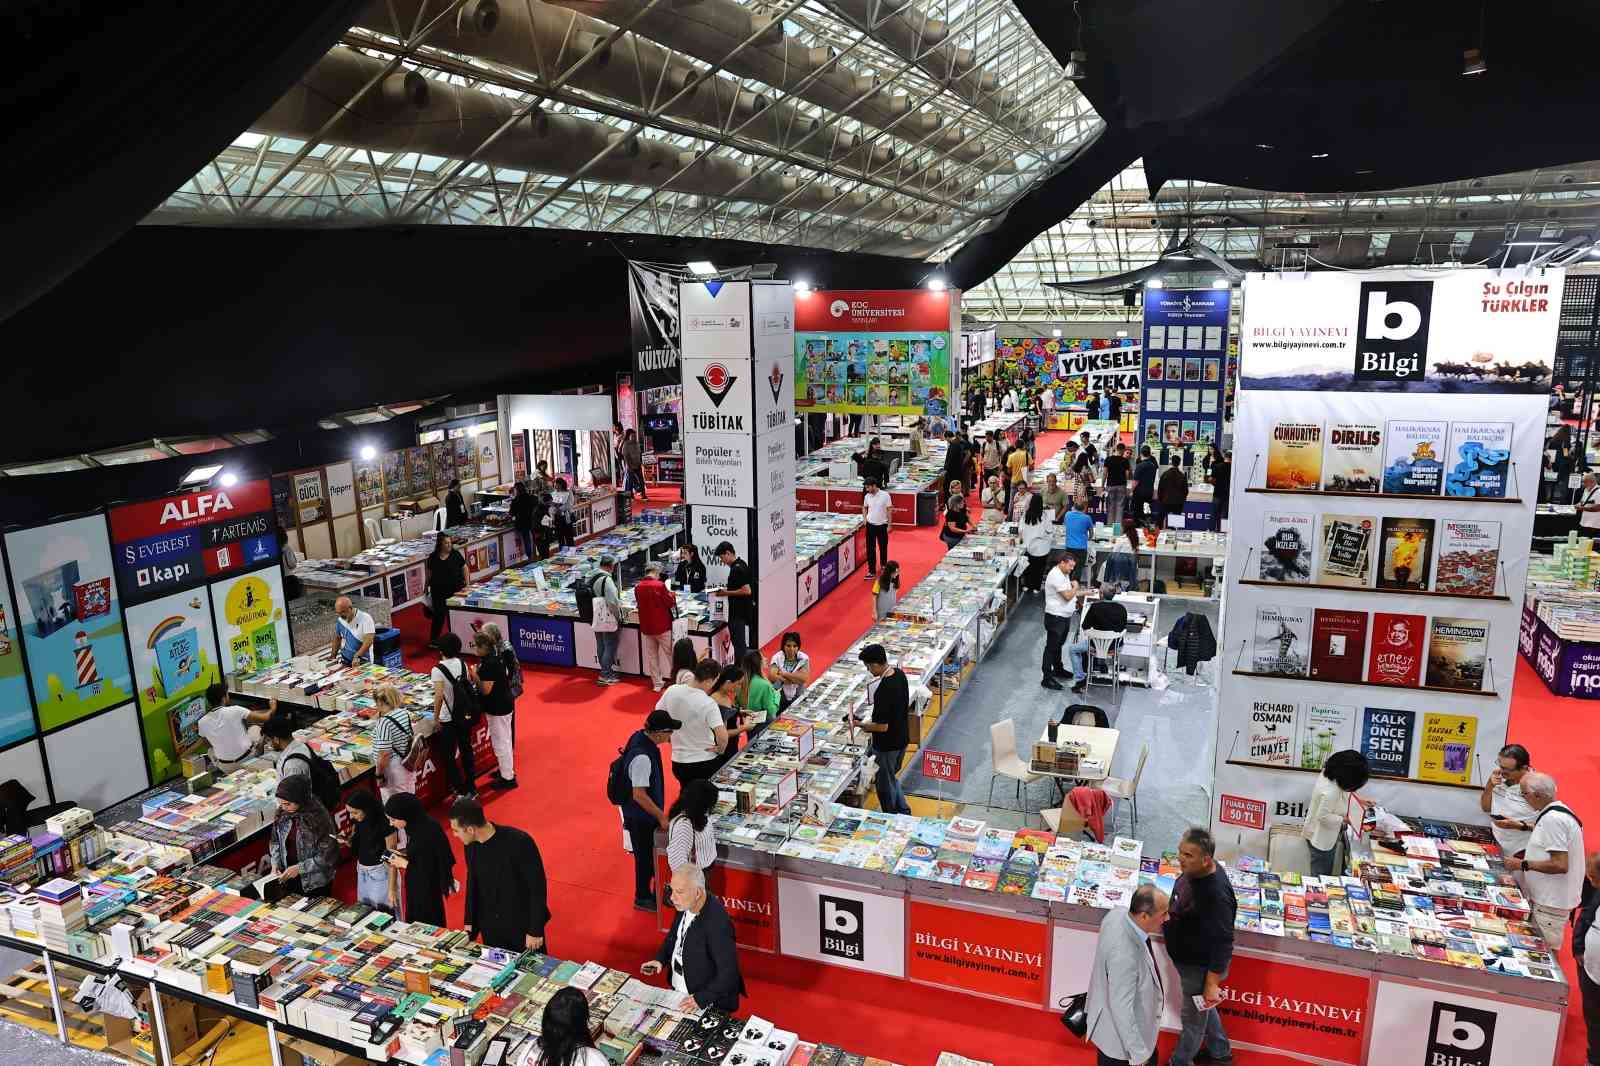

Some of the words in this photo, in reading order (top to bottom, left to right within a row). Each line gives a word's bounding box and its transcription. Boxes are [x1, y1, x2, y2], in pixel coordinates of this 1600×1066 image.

[1506, 280, 1549, 298] Çılgın
[1481, 299, 1549, 313] TÜRKLER
[1365, 291, 1422, 341] b
[1253, 325, 1286, 337] BİLGİ
[1290, 325, 1348, 337] YAYINEVİ
[1252, 339, 1346, 350] www.bilgiyayinevi.com.tr
[638, 345, 678, 372] KÜLTÜR
[1361, 352, 1419, 377] Bilgi
[1092, 374, 1141, 391] ZEKA
[692, 411, 744, 431] TÜBİTAK
[695, 446, 733, 460] Popüler
[299, 481, 320, 501] GÜCÜ
[159, 491, 235, 526] ALFA
[701, 514, 728, 527] Bilim
[706, 526, 739, 537] Çocuk
[137, 535, 192, 560] EVEREST
[255, 631, 272, 644] avni
[519, 628, 555, 643] Popüler
[1435, 626, 1486, 638] HEMINGWAY
[233, 636, 250, 651] avni
[1252, 712, 1292, 724] OSMAN
[1371, 713, 1407, 726] KALK
[1370, 723, 1406, 738] ÖNCE
[1369, 737, 1405, 752] SEN
[941, 764, 952, 777] 30
[1230, 809, 1242, 820] 50
[1243, 811, 1256, 824] TL
[720, 896, 772, 916] YINEVİ
[825, 901, 858, 935] b
[825, 937, 859, 957] Bilgi
[914, 931, 960, 951] BİLGİ
[962, 941, 1045, 968] YAYINEVİ
[1266, 994, 1361, 1024] YAYINEVİ
[1436, 1009, 1486, 1050] b
